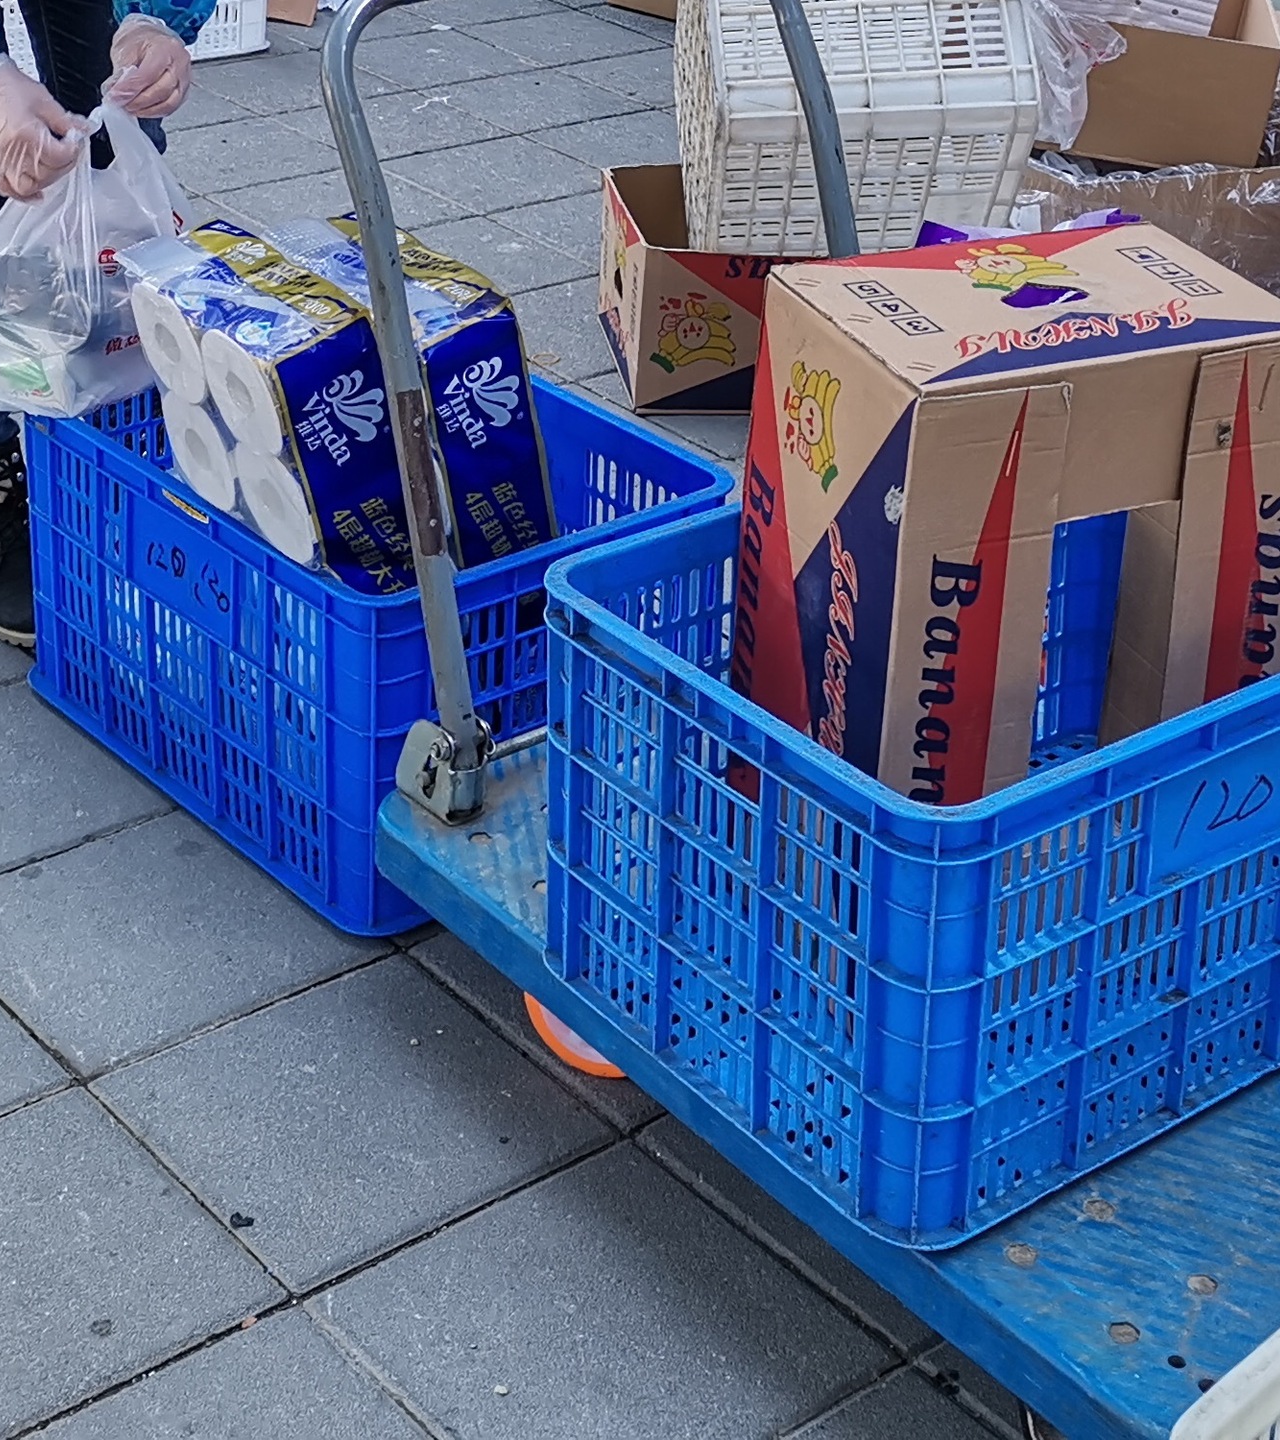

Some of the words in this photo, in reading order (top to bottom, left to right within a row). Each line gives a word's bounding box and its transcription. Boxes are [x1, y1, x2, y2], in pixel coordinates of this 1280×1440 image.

[294, 420, 322, 452] 维达
[302, 392, 351, 467] Vinda
[435, 403, 459, 434] 维达
[443, 374, 488, 450] Vinda
[491, 480, 540, 549] 蓝色经
[731, 457, 776, 698] Banan
[908, 554, 982, 806] Banan
[1173, 774, 1273, 850] 120
